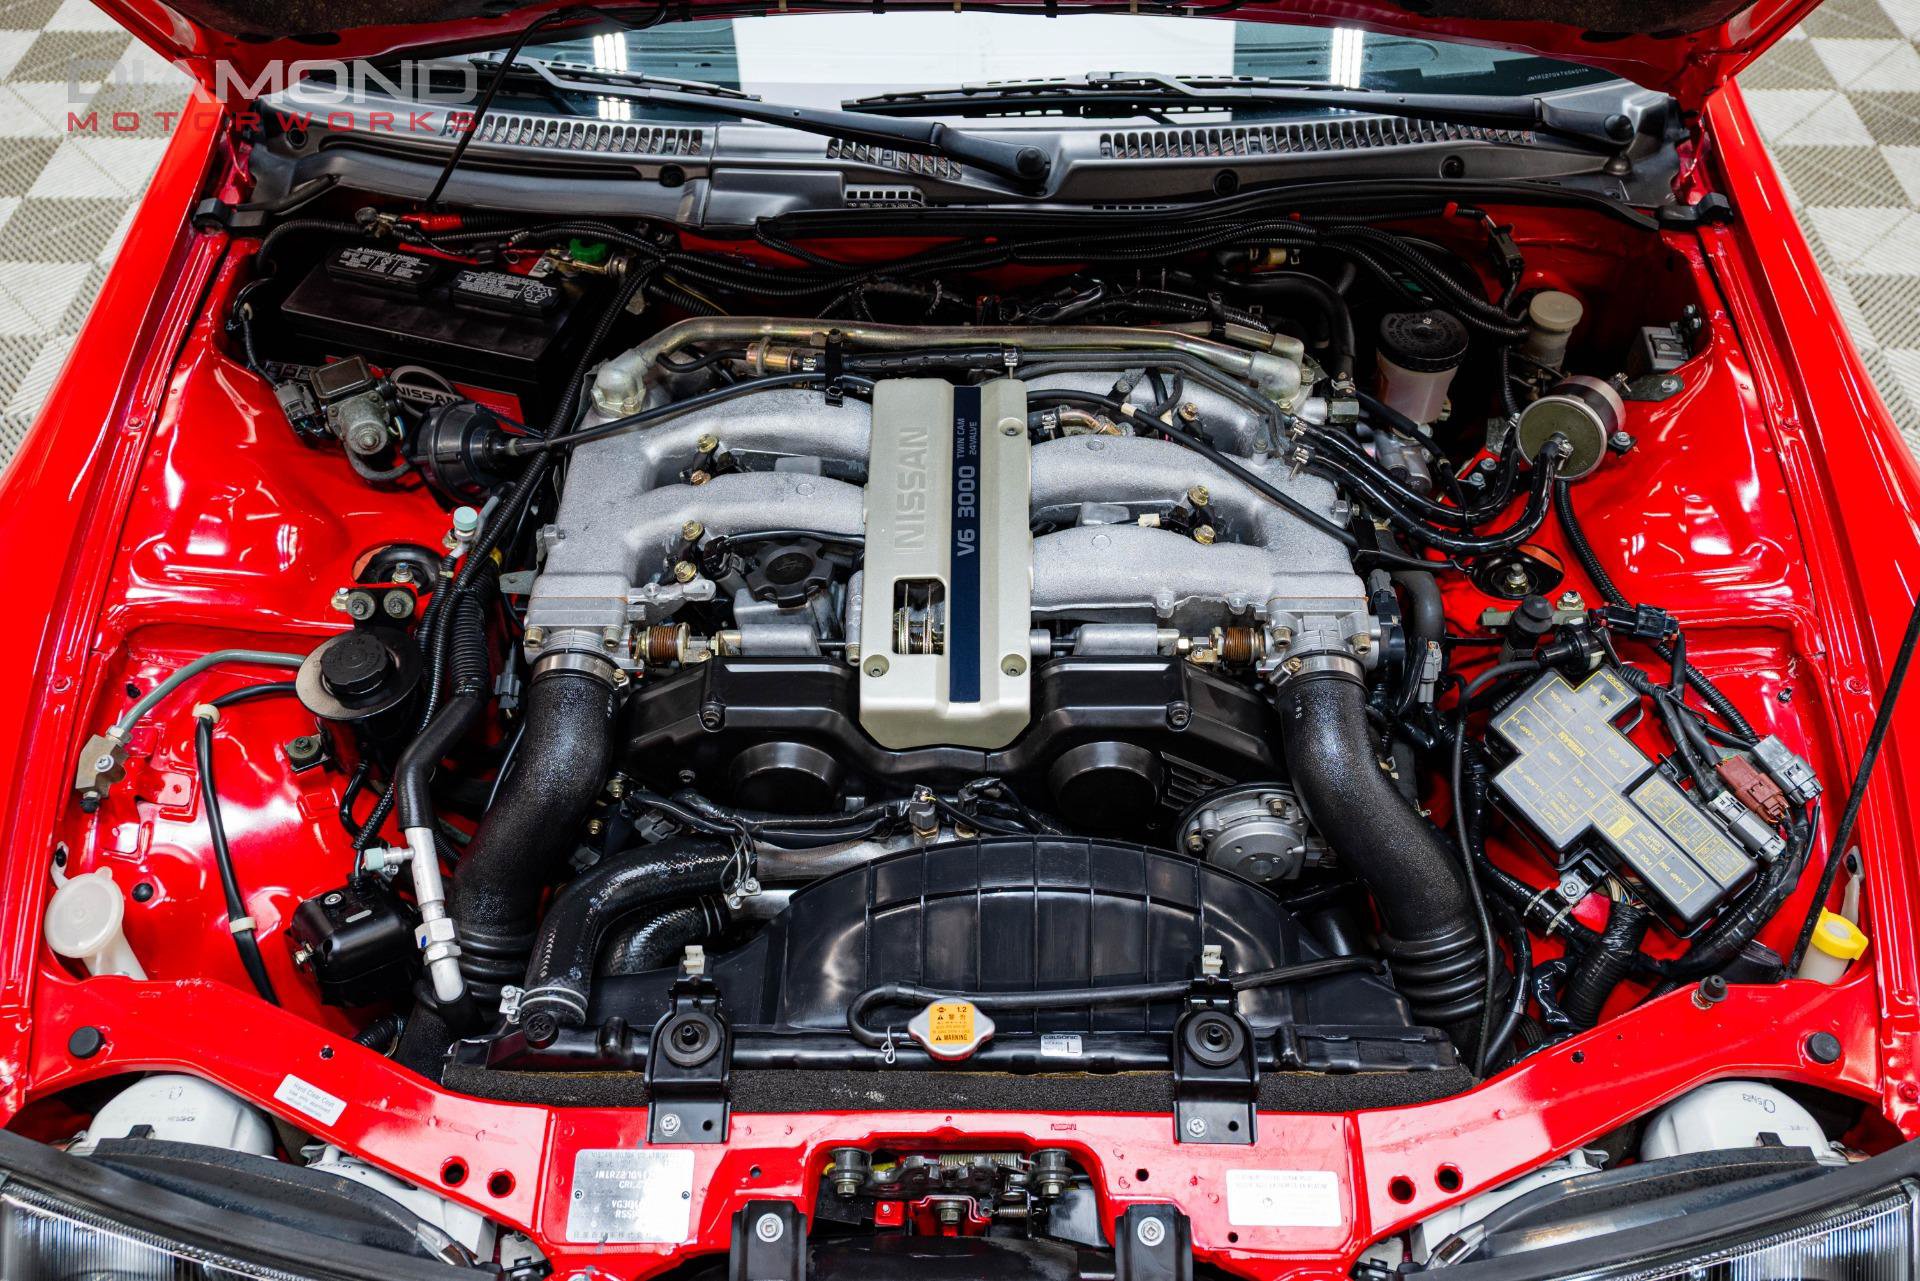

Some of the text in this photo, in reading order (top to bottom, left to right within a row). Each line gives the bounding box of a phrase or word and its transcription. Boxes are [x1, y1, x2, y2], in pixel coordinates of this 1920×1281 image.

[894, 426, 929, 551] NISSAN
[956, 418, 976, 557] V6 3000 TWIN CAM
[968, 421, 978, 455] 24VALVE
